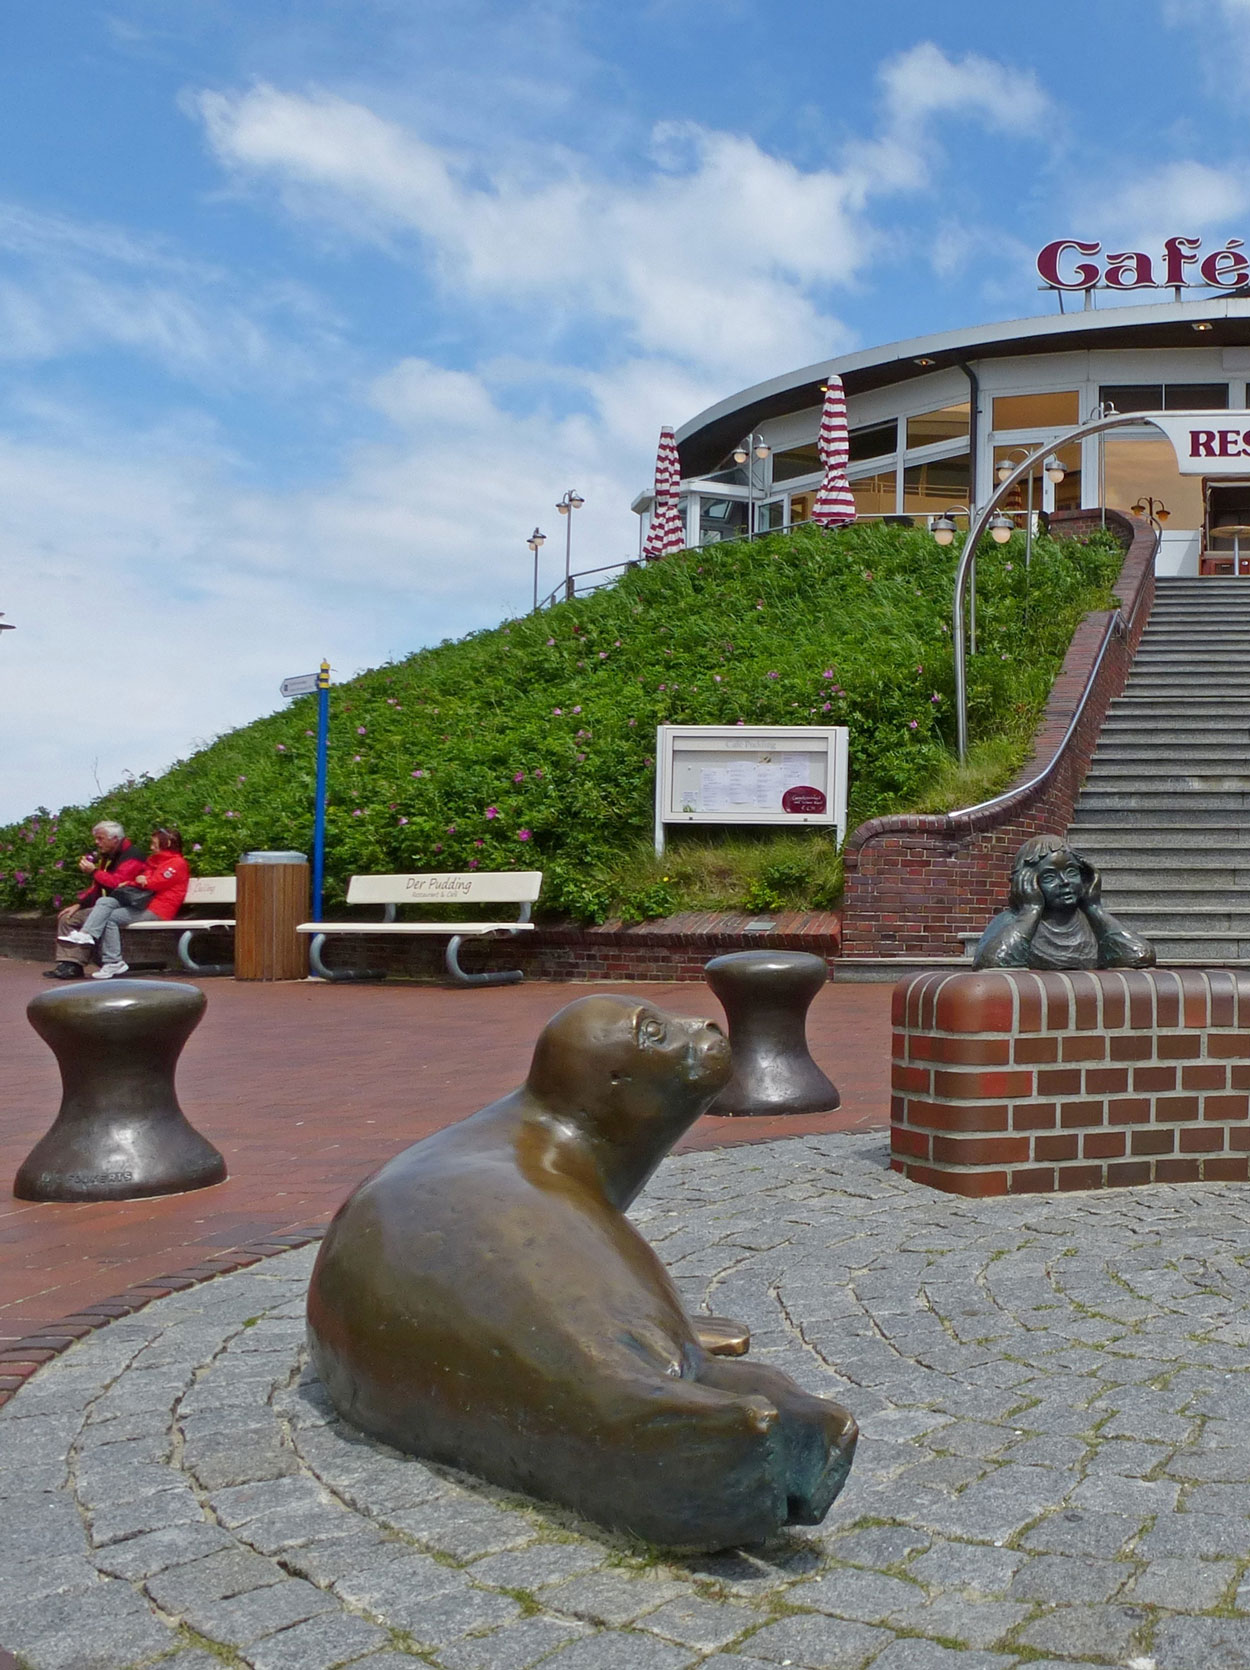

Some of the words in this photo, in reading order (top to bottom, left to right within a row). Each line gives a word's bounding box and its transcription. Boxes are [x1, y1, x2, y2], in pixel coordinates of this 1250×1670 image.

[1036, 236, 1250, 291] Café
[406, 878, 426, 890] Der
[428, 877, 473, 895] Pudding
